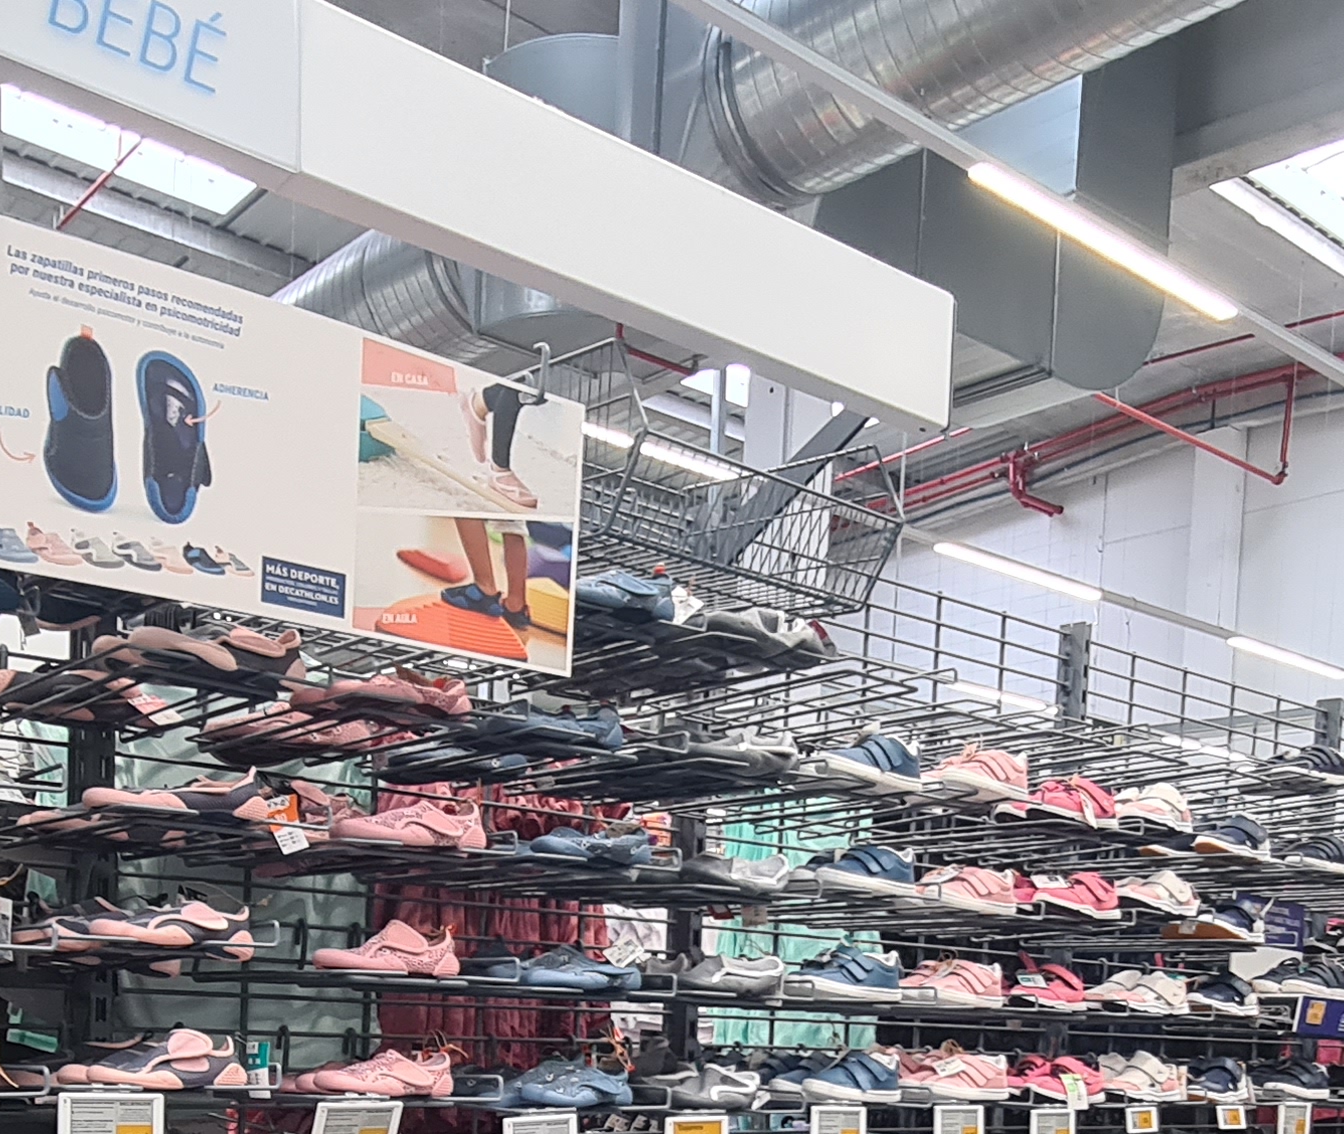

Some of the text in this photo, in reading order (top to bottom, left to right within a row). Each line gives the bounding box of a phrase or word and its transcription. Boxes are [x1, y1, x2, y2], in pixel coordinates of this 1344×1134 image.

[7, 245, 244, 325] Las zapatillas primeros pasos recomendadas
[10, 262, 241, 338] por nuestra especialista en psicomotricidad
[212, 383, 269, 401] ADHERENCIA
[404, 373, 429, 386] CASA
[265, 563, 288, 578] MÁS
[290, 569, 340, 589] DEPORTE,
[264, 582, 277, 593] EN
[278, 583, 339, 606] DECATHLON.ES
